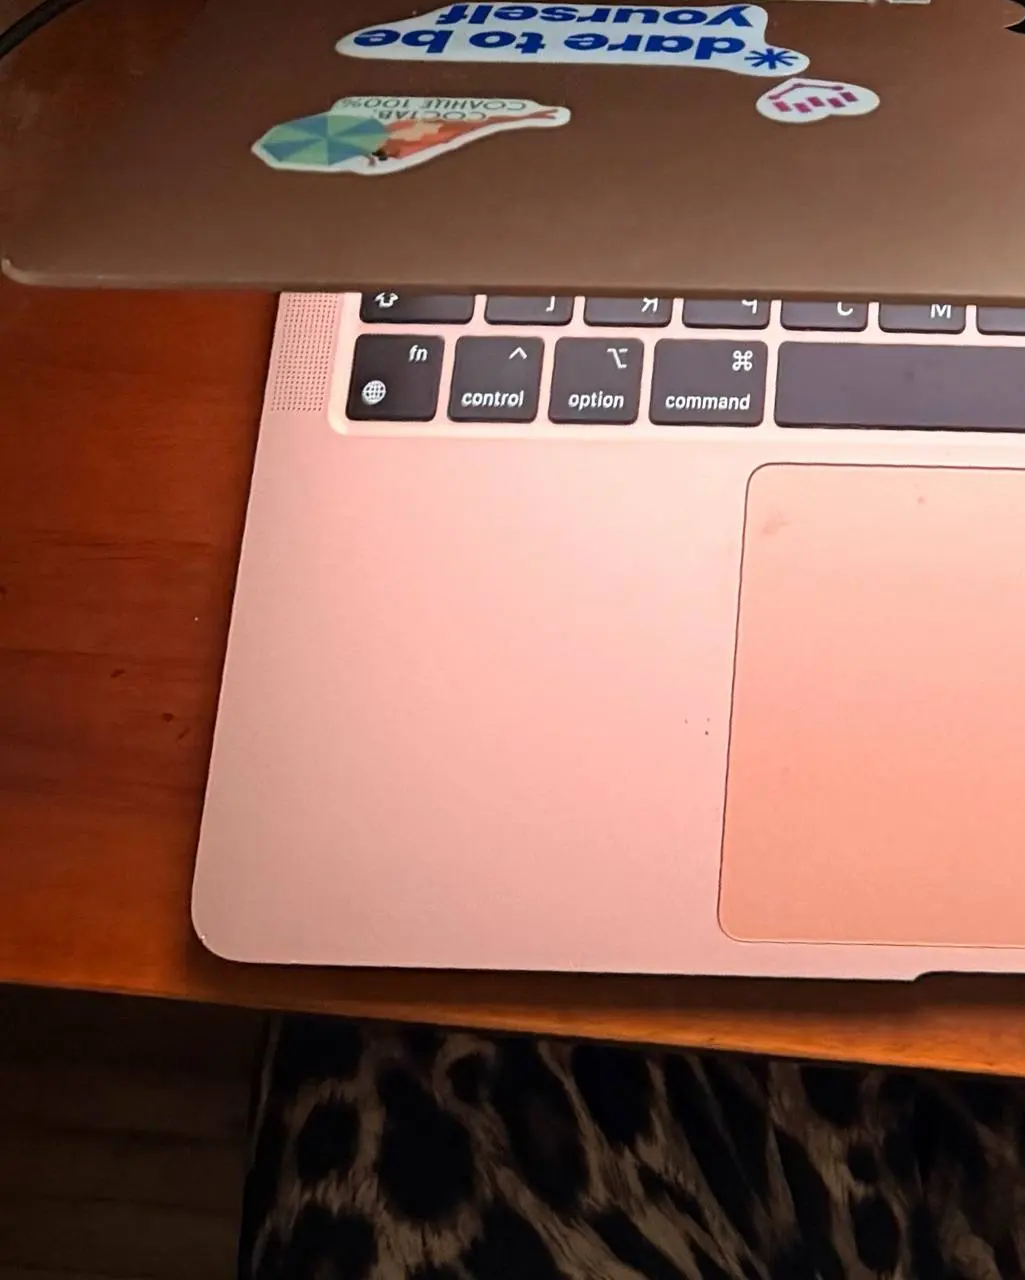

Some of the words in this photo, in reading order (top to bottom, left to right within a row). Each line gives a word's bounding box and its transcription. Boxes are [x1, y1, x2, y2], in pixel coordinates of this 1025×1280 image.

[432, 3, 755, 28] yourself
[352, 27, 454, 56] be
[470, 30, 546, 58] to
[564, 32, 745, 62] dare
[343, 97, 411, 110] 100%
[409, 345, 428, 362] fn
[460, 390, 525, 408] control
[568, 391, 625, 410] option
[664, 393, 752, 412] command
